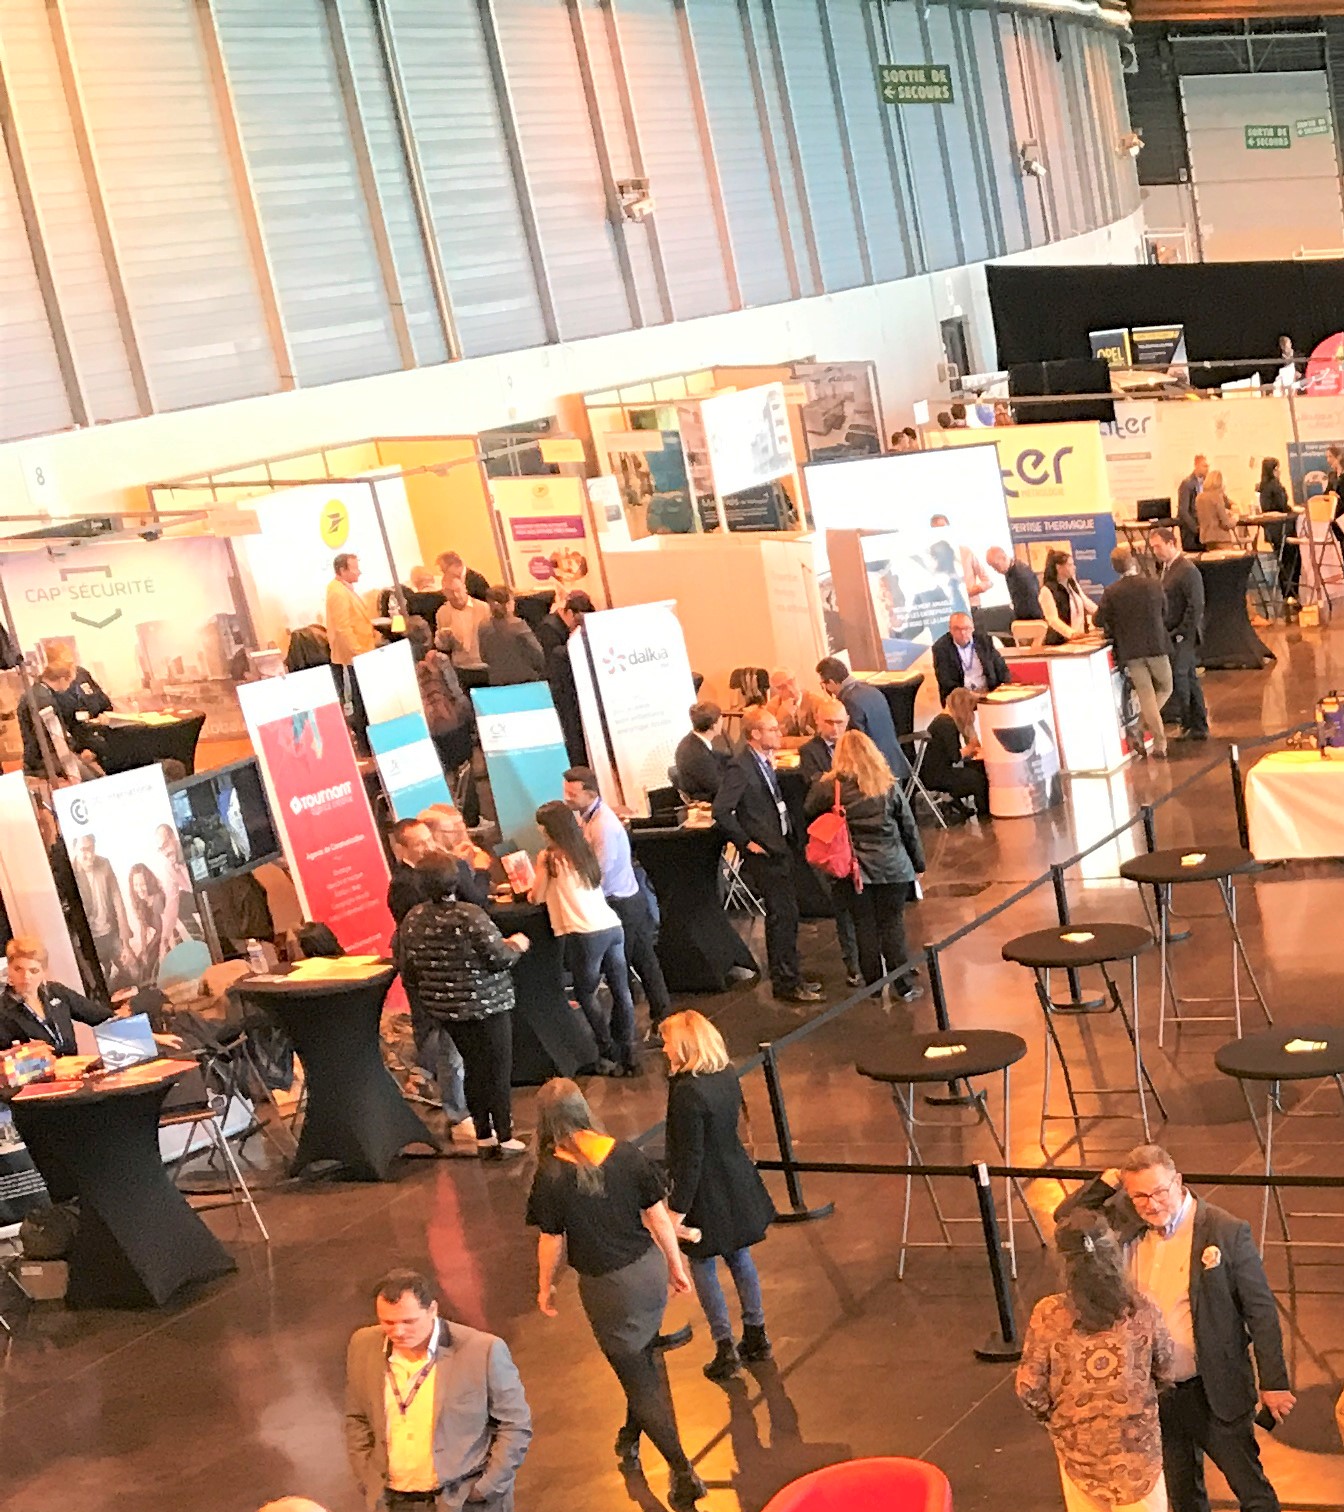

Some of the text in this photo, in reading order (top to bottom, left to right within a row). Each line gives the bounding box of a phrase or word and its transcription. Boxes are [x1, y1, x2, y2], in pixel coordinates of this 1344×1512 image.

[882, 69, 948, 83] SORTIE DE
[898, 85, 950, 99] SECOURS
[1247, 127, 1274, 137] SORTIE
[1256, 137, 1289, 146] SECOURS
[36, 466, 46, 486] 8
[25, 577, 156, 603] CAP SÉCURITÉ
[628, 646, 669, 666] dalkia
